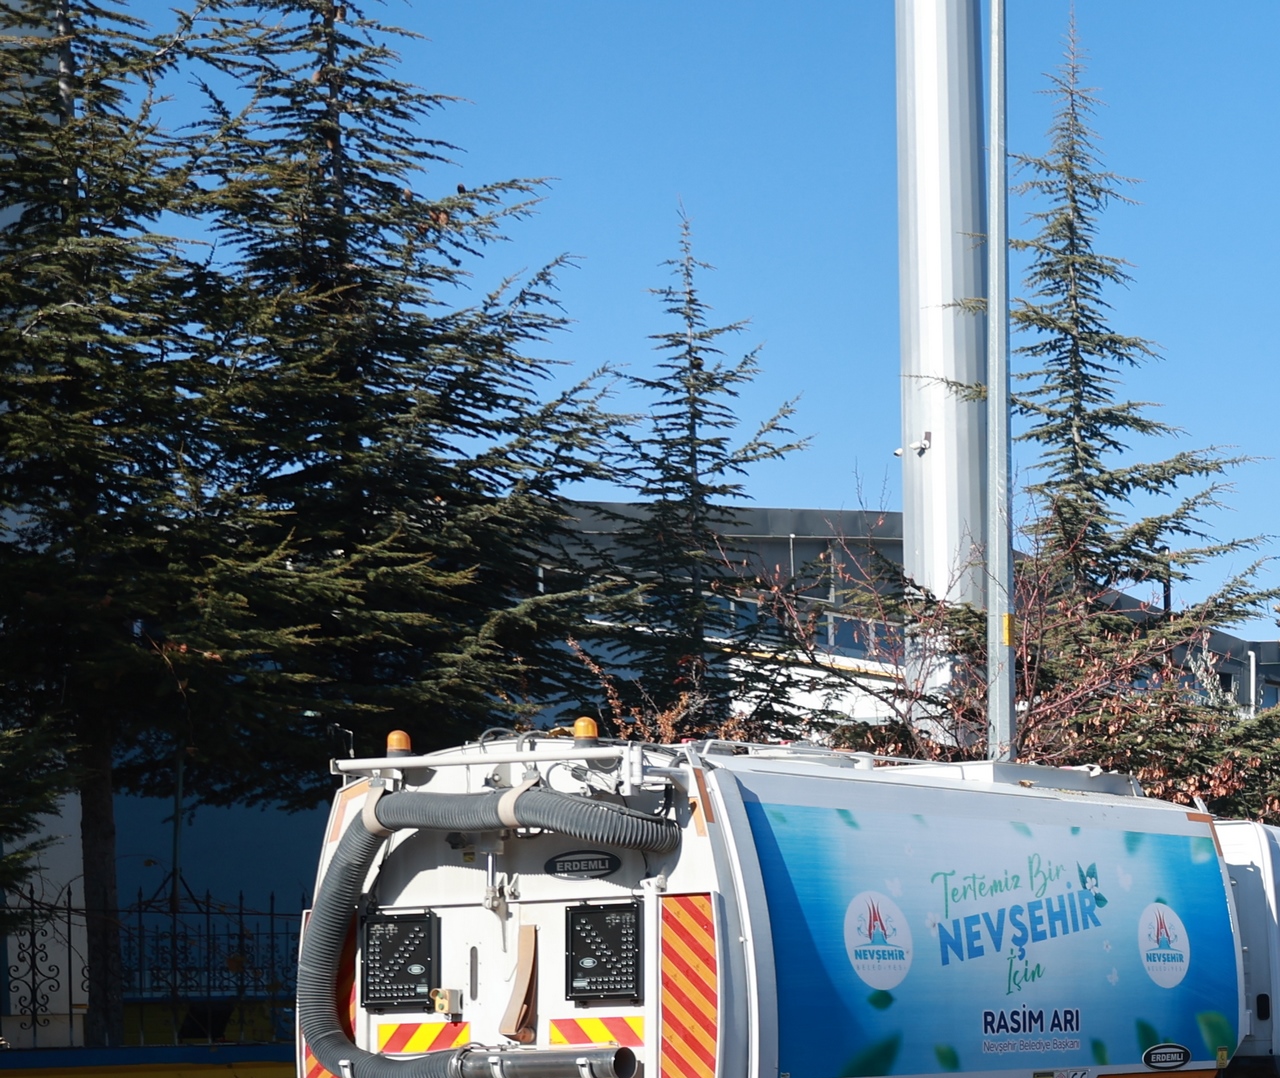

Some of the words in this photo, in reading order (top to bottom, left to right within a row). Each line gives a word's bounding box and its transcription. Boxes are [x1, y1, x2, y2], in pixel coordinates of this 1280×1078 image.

[556, 860, 609, 871] ERDEMLI
[931, 869, 1023, 919] Tertemiz
[1027, 853, 1067, 898] Bir
[937, 881, 1102, 966] NEVŞEHİR
[1006, 948, 1046, 995] İçin
[983, 1004, 1044, 1034] RASİM
[1049, 1009, 1080, 1032] ARI
[983, 1041, 1017, 1055] Nevşehir
[1020, 1040, 1051, 1052] Belediye
[1052, 1038, 1080, 1051] Başkanı
[1151, 1053, 1184, 1062] ERDEMLI
